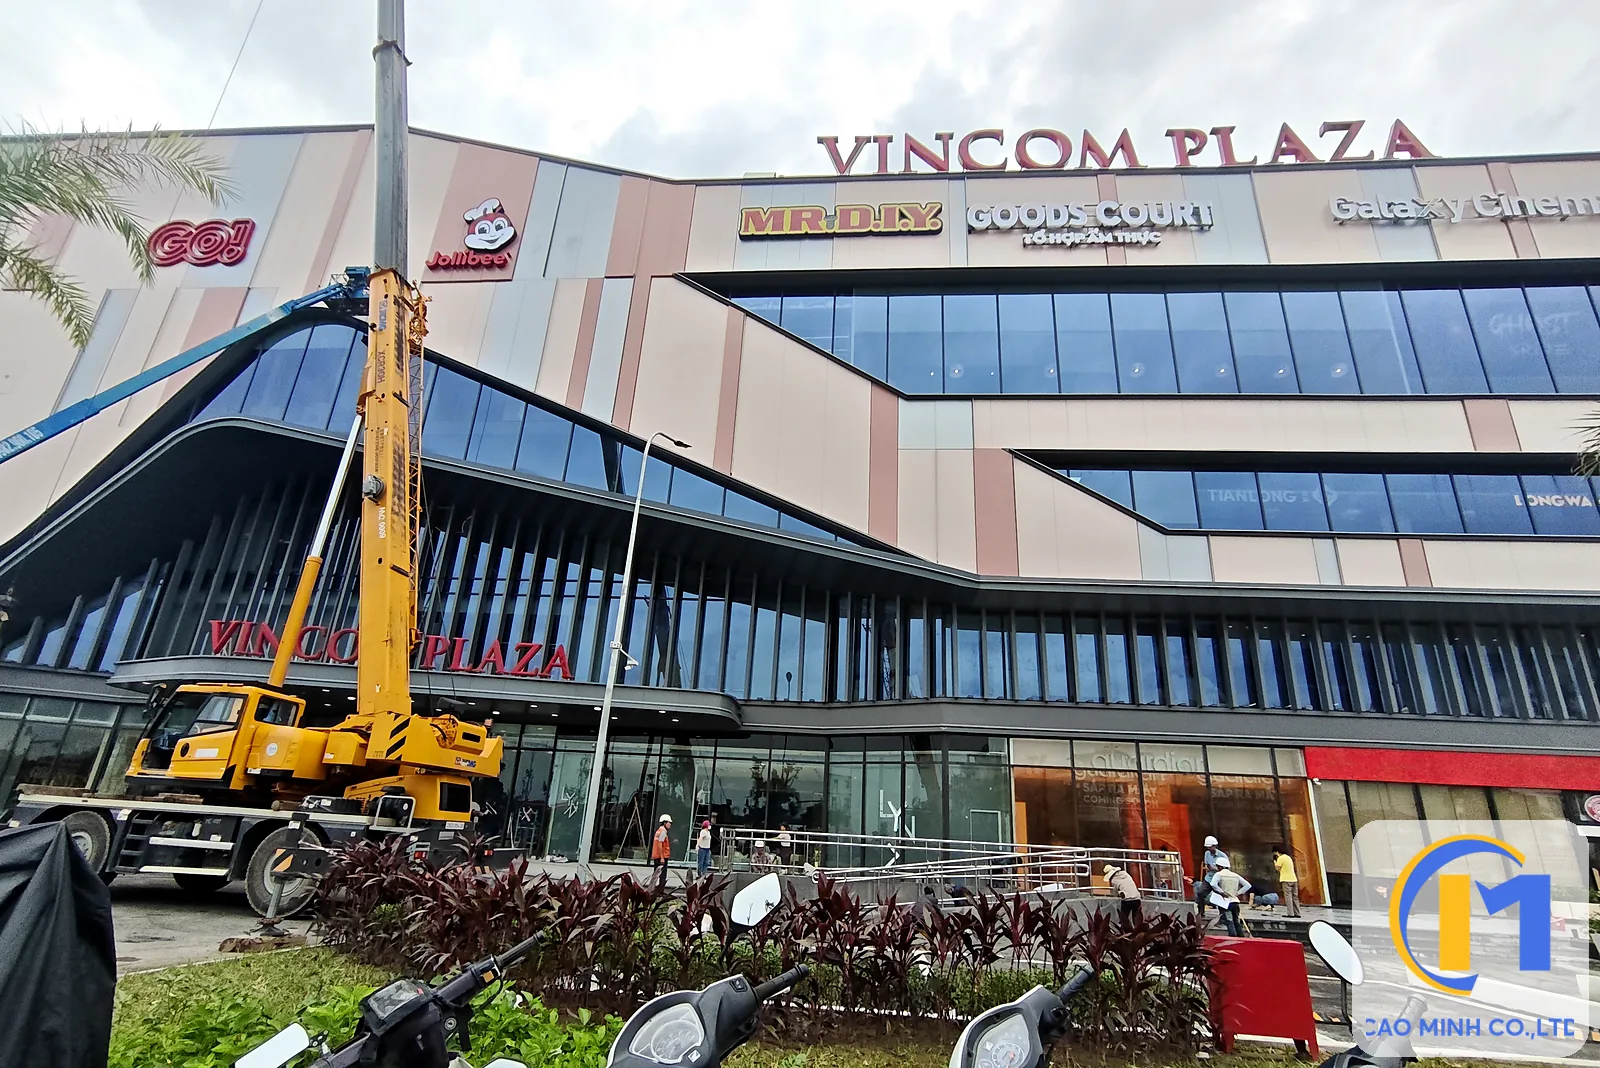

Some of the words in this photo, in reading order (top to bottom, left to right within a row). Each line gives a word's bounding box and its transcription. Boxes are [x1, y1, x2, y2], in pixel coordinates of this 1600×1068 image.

[817, 127, 1149, 176] VINCOM
[1164, 118, 1443, 167] PLAZA
[967, 202, 1088, 231] GOODS
[1095, 199, 1215, 229] COURT
[1328, 195, 1466, 223] Galaxy
[1471, 190, 1600, 218] Cinem
[147, 217, 256, 267] GO!
[425, 248, 510, 272] Jollibee
[209, 619, 359, 663] VINCO
[420, 634, 575, 680] PLAZA
